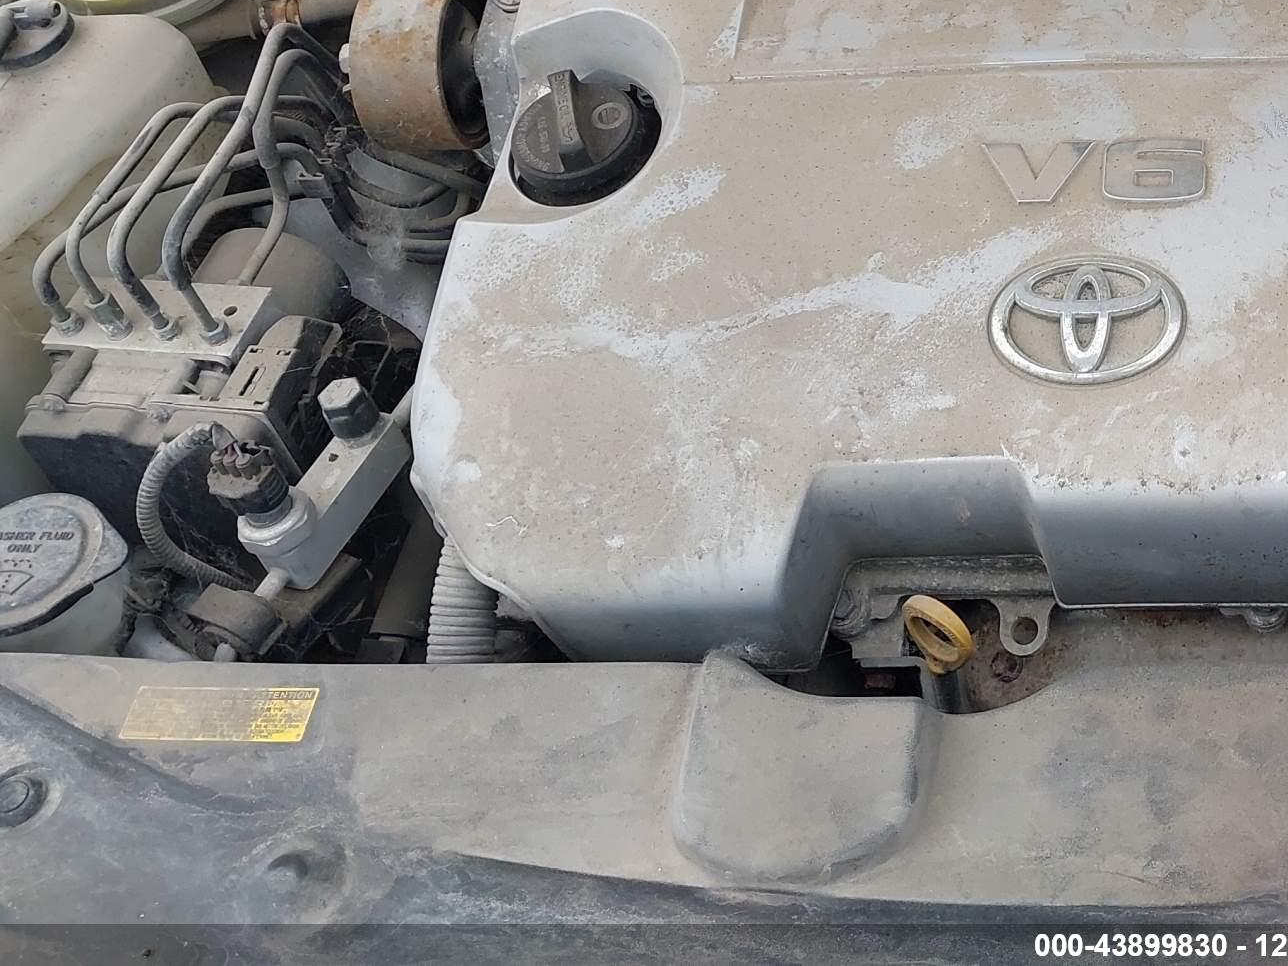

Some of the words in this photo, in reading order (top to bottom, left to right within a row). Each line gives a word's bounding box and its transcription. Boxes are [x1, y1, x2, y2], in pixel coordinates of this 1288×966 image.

[981, 138, 1208, 203] V6
[39, 531, 74, 541] FLUID
[7, 543, 42, 553] ONLY
